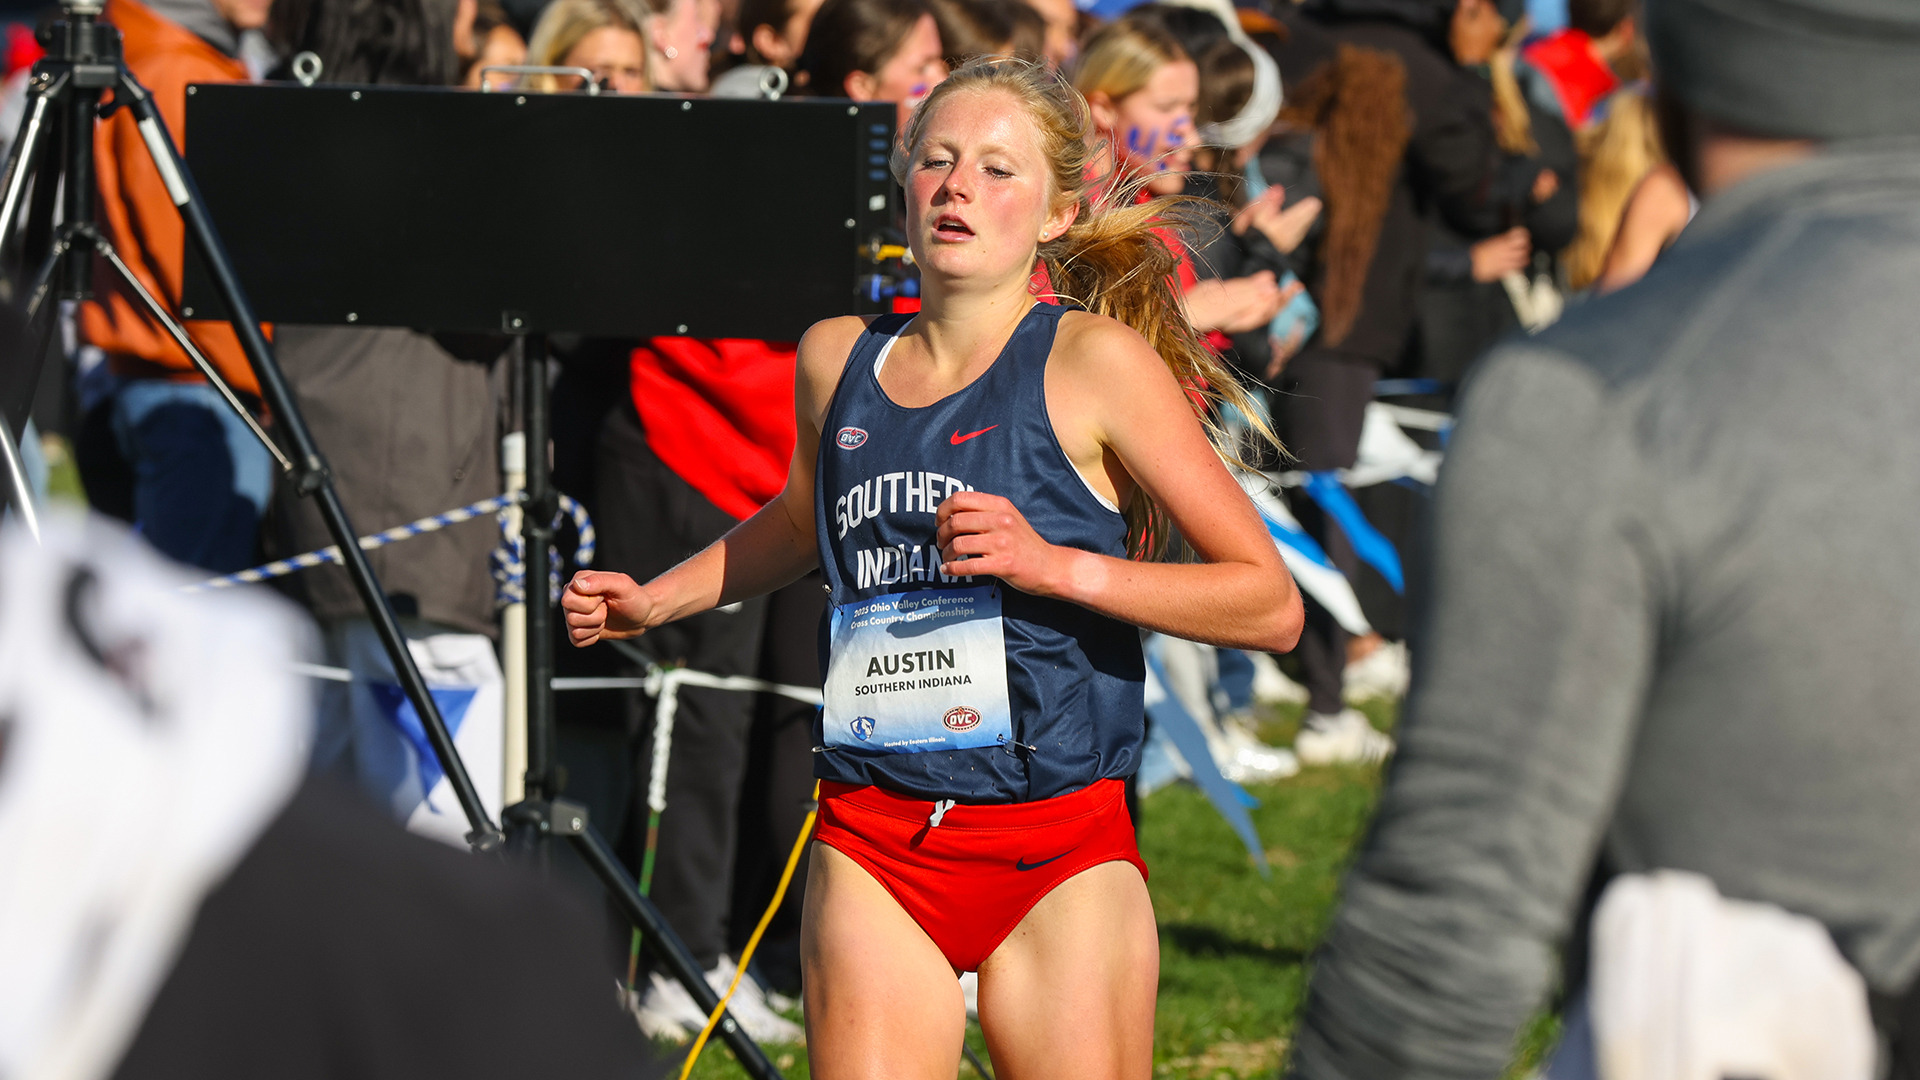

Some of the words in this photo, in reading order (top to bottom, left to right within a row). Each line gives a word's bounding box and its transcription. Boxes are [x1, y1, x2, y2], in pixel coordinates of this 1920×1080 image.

[835, 471, 975, 541] SOUTHE
[854, 605, 869, 618] 2025
[870, 602, 891, 613] Ohio
[891, 599, 919, 611] Valley
[921, 596, 974, 607] Conference
[851, 616, 868, 630] Cross
[869, 613, 905, 625] Country
[906, 607, 975, 621] Championships
[866, 648, 955, 678] AUSTIN
[855, 680, 916, 696] SOUTHERN
[918, 675, 972, 689] INDIANA
[950, 713, 972, 725] OVC
